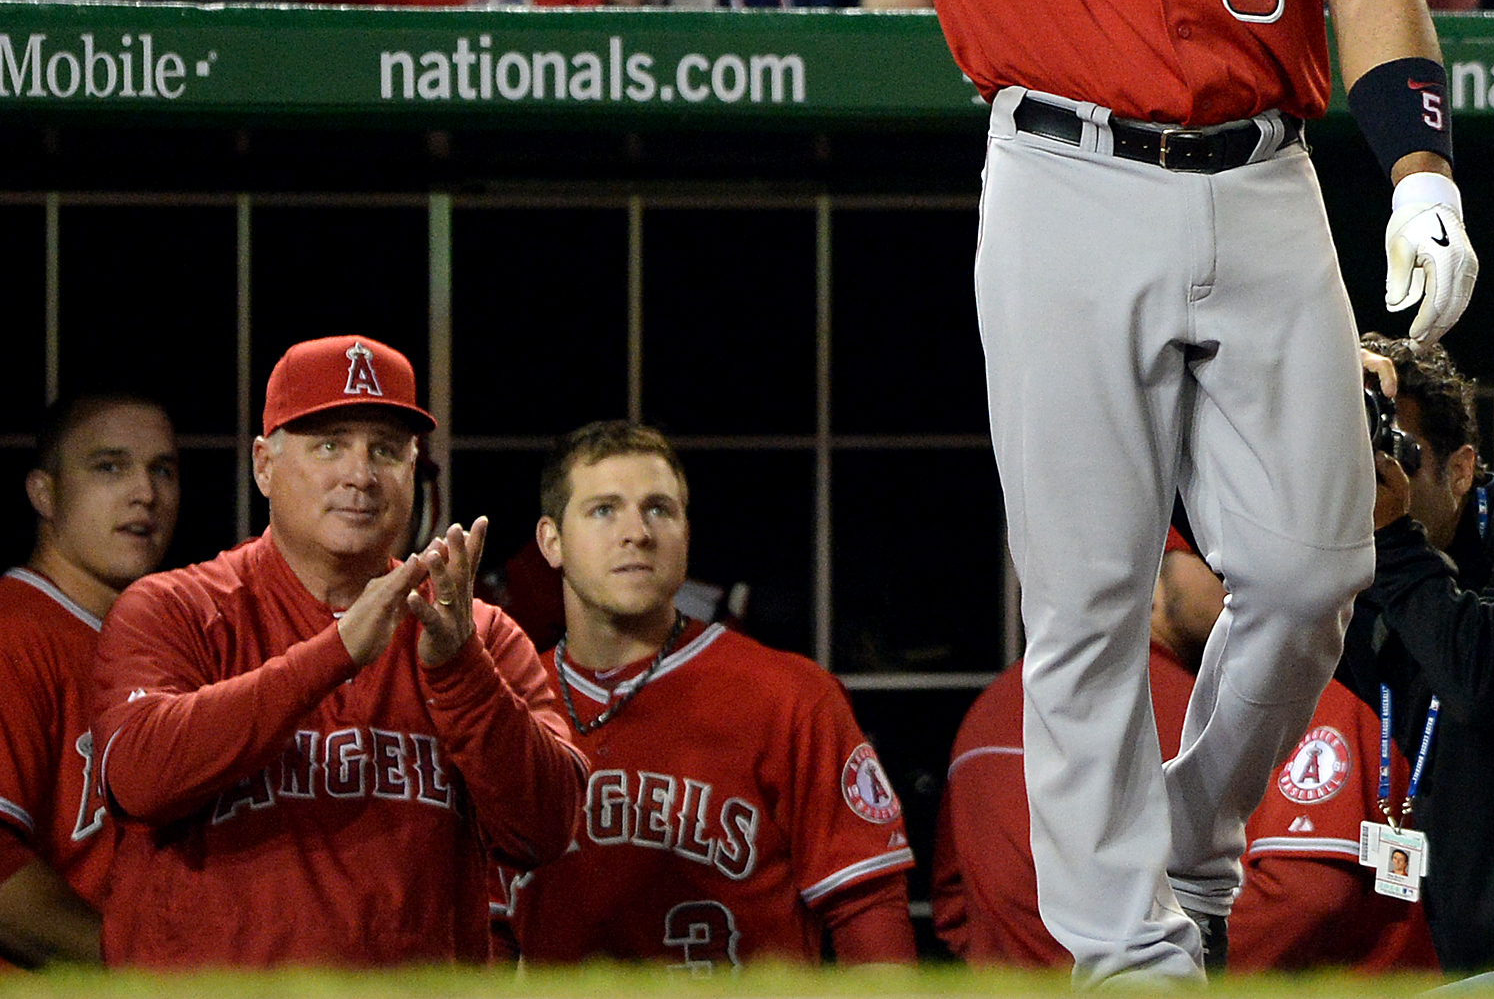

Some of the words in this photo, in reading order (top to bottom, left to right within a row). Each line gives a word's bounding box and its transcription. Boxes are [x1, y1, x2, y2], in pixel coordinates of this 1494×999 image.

[380, 36, 805, 103] nationals.com
[1421, 90, 1443, 131] 5
[344, 341, 383, 397] A
[583, 768, 758, 881] GELS
